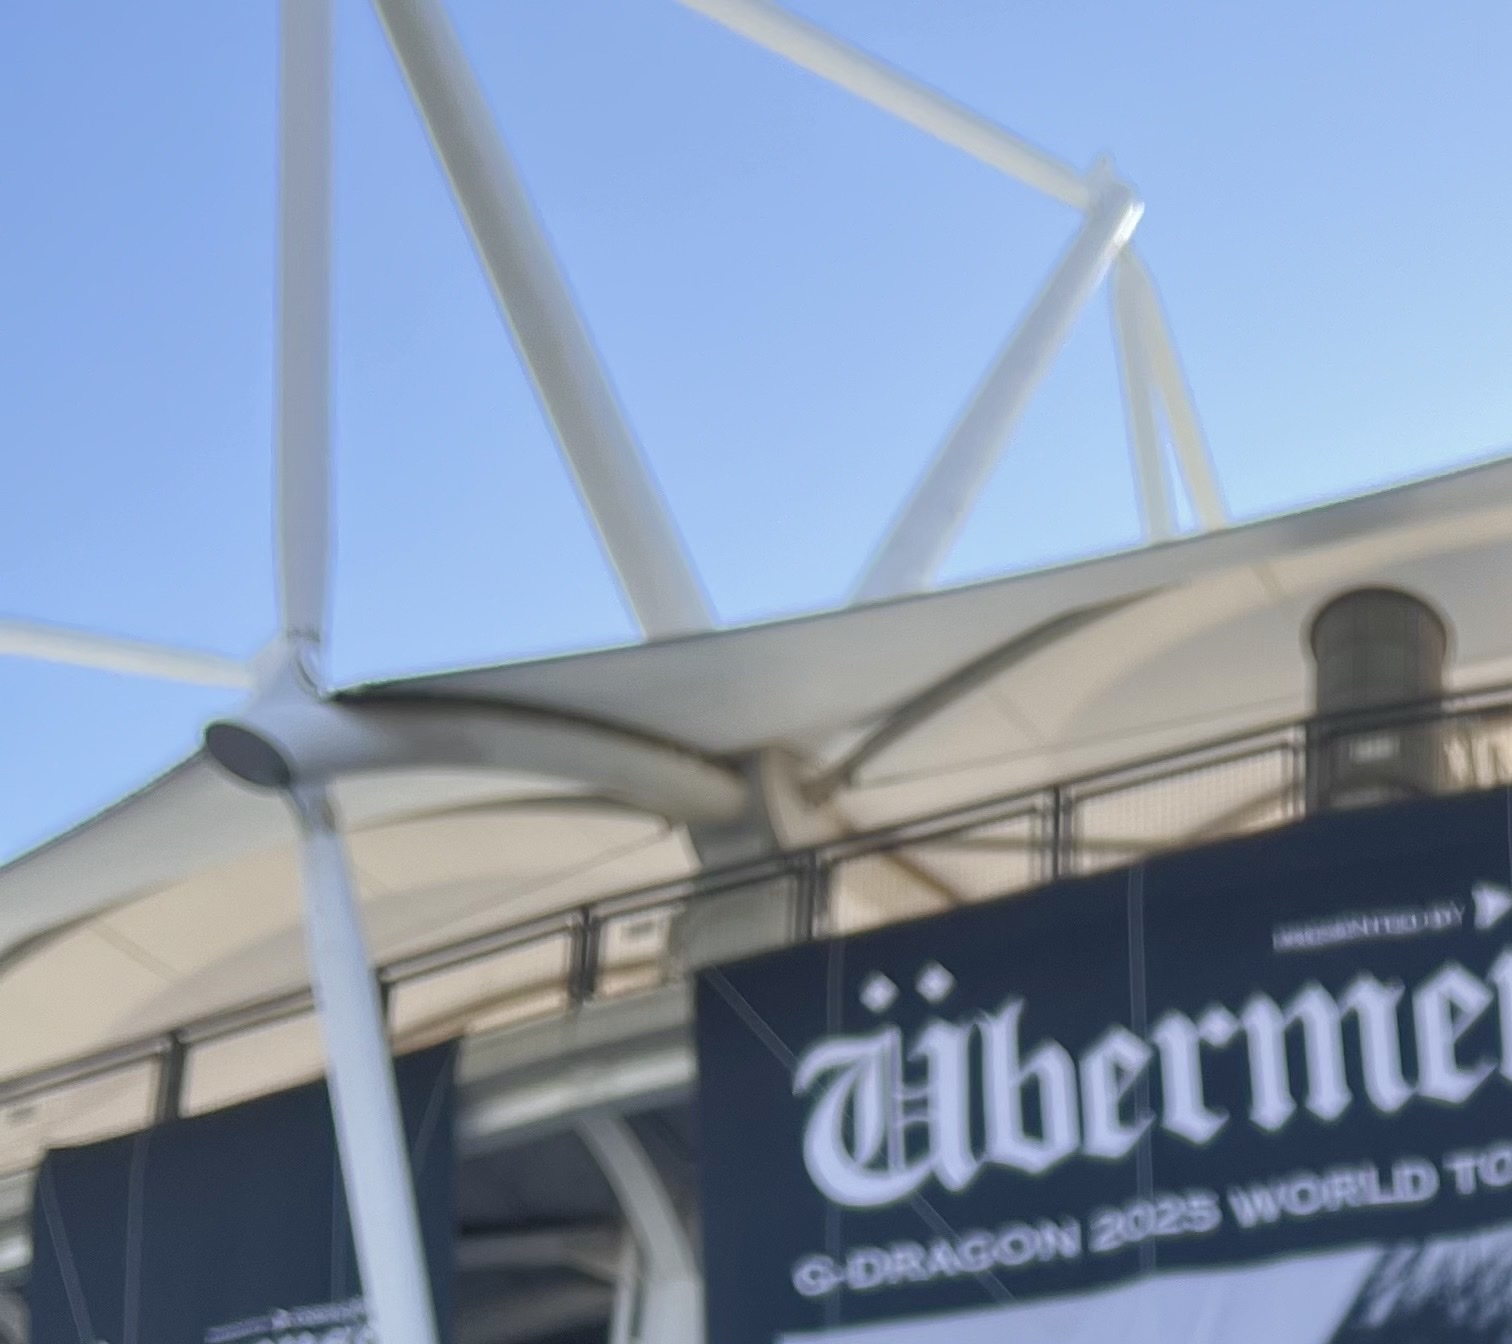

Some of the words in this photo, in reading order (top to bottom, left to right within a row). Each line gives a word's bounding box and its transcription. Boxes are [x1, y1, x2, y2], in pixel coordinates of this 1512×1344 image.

[794, 1217, 1082, 1296] G-DRAGON
[1089, 1188, 1222, 1252] 2025
[1227, 1158, 1438, 1228] WORLD
